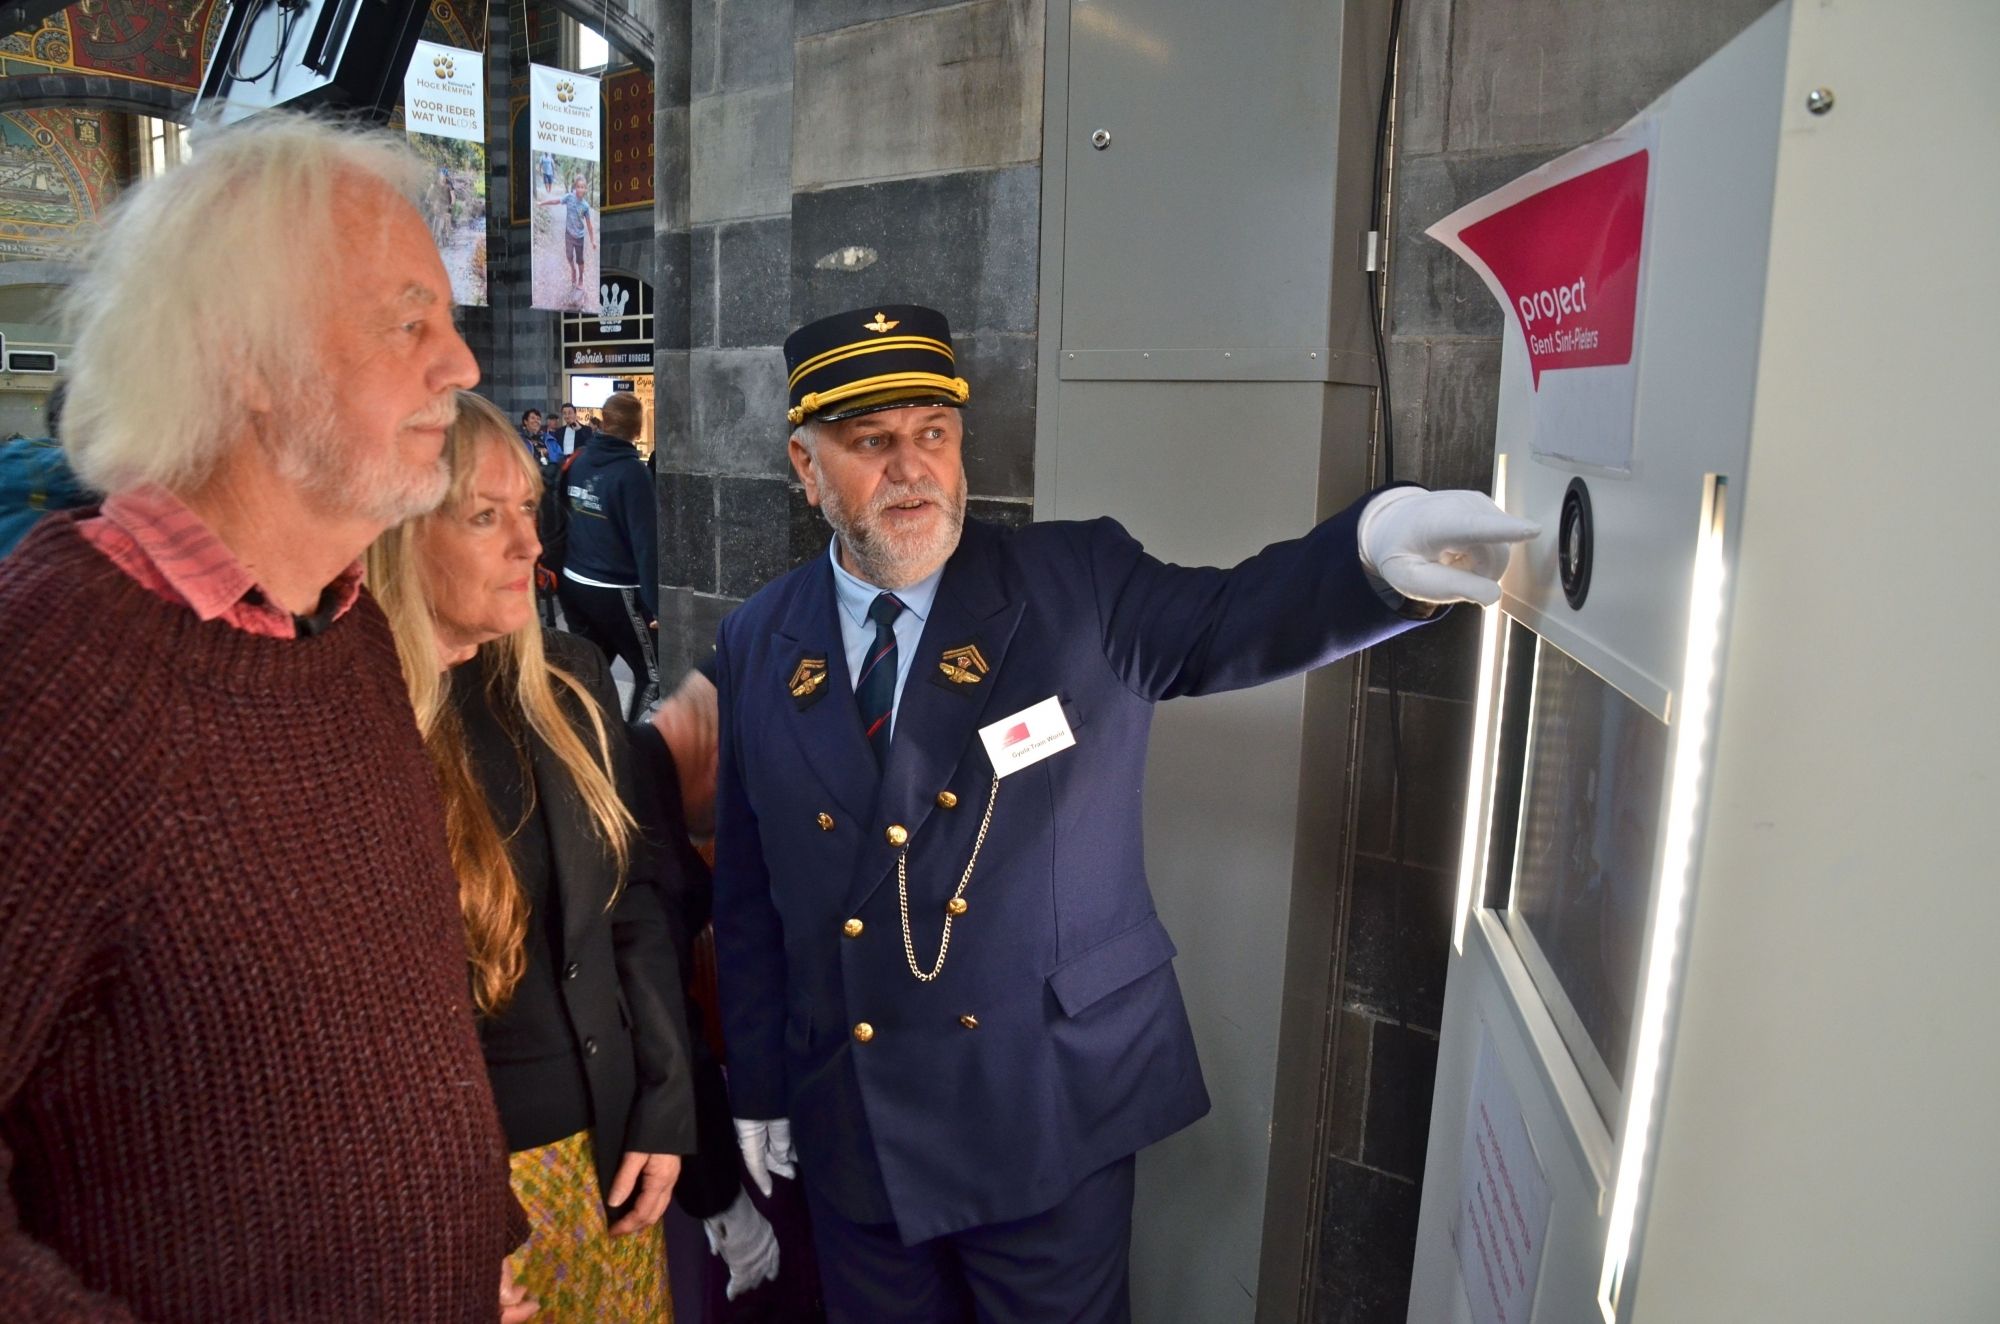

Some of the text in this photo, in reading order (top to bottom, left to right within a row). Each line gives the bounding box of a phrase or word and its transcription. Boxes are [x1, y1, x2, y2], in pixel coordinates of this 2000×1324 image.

[442, 83, 473, 96] KEMPEN
[413, 98, 476, 118] VOOR IEDER
[563, 106, 591, 118] KEMPEN
[411, 110, 478, 130] WAT WIL(D)S
[538, 120, 593, 139] VOOR IEDER
[537, 131, 557, 142] WAT
[1519, 276, 1587, 330] project
[1530, 327, 1599, 356] Gent Sint-Pieters
[1011, 730, 1065, 759] Gyula Train World
